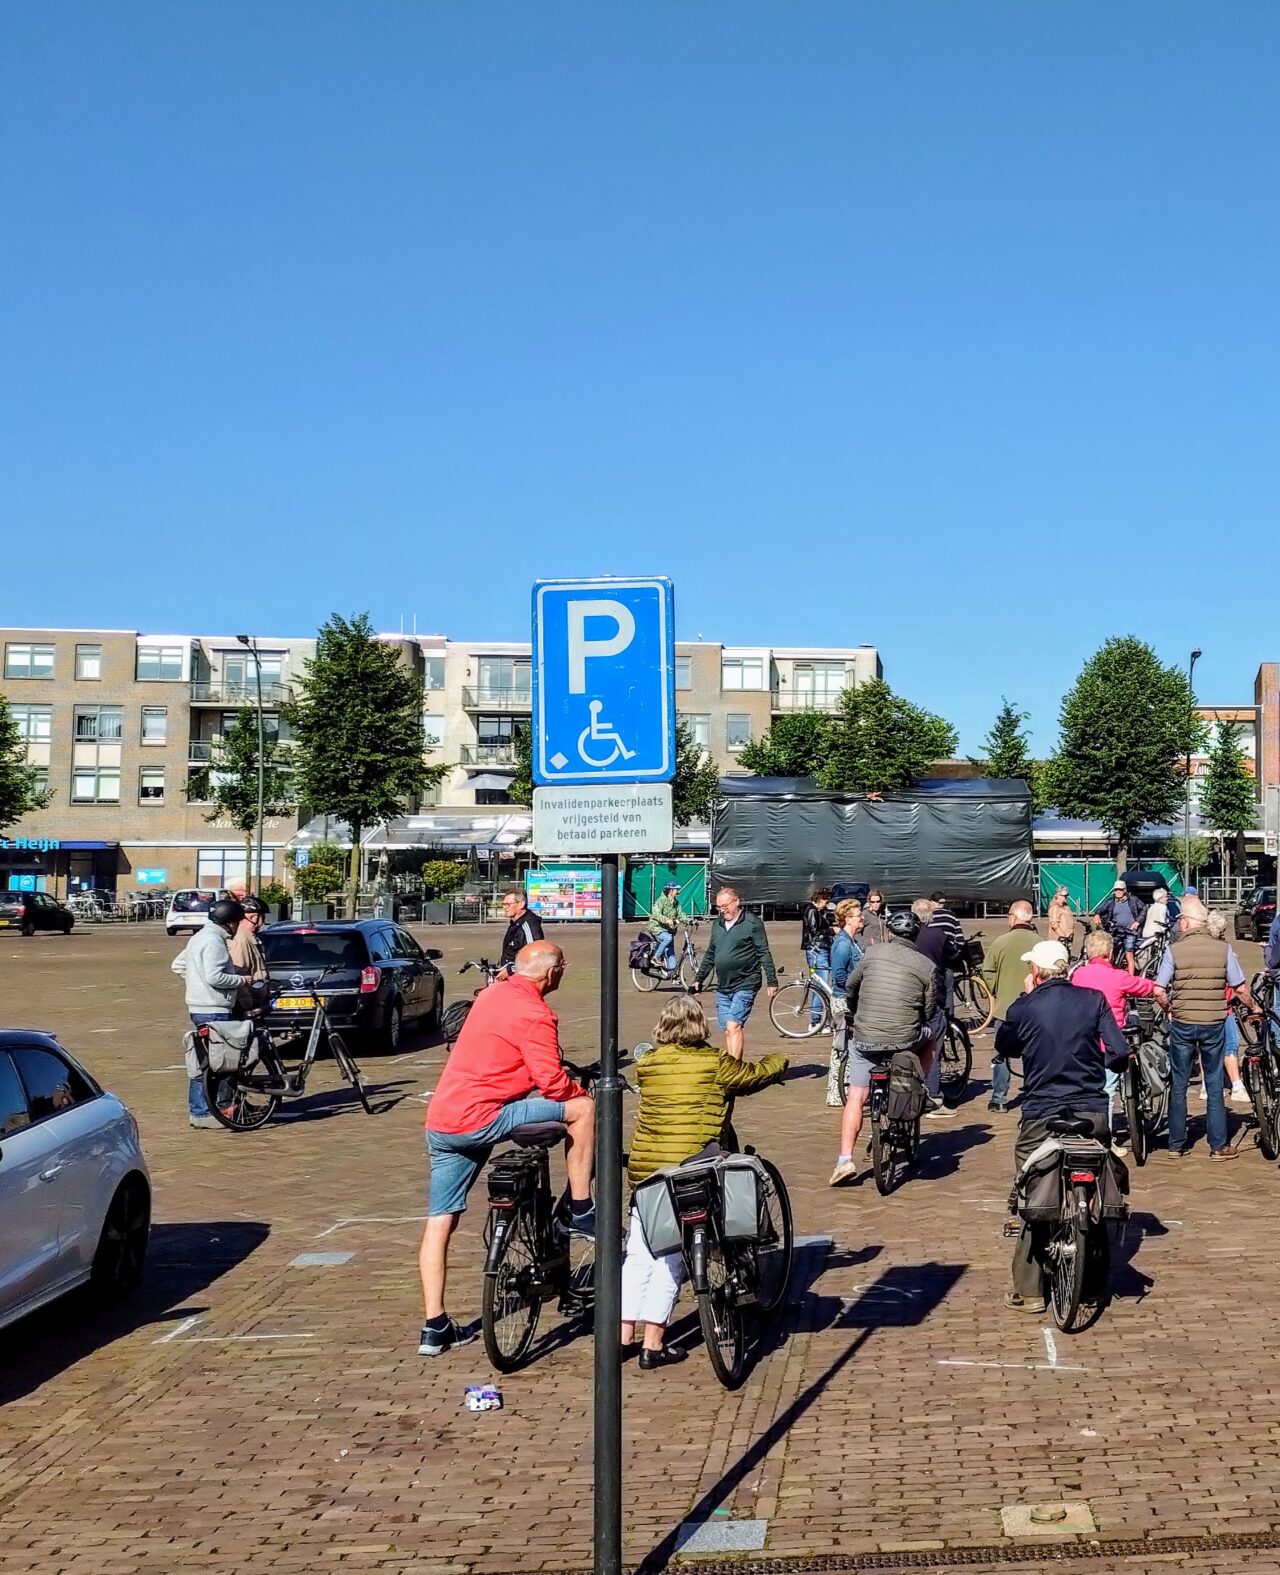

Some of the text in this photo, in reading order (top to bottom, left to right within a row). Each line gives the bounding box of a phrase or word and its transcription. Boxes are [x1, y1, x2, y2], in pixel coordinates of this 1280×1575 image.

[567, 600, 636, 695] P
[540, 796, 664, 810] Invalidenparkeerplaats
[562, 812, 642, 827] vrijgesteld van
[557, 827, 647, 841] betaald parkeren
[15, 836, 60, 853] Heijn
